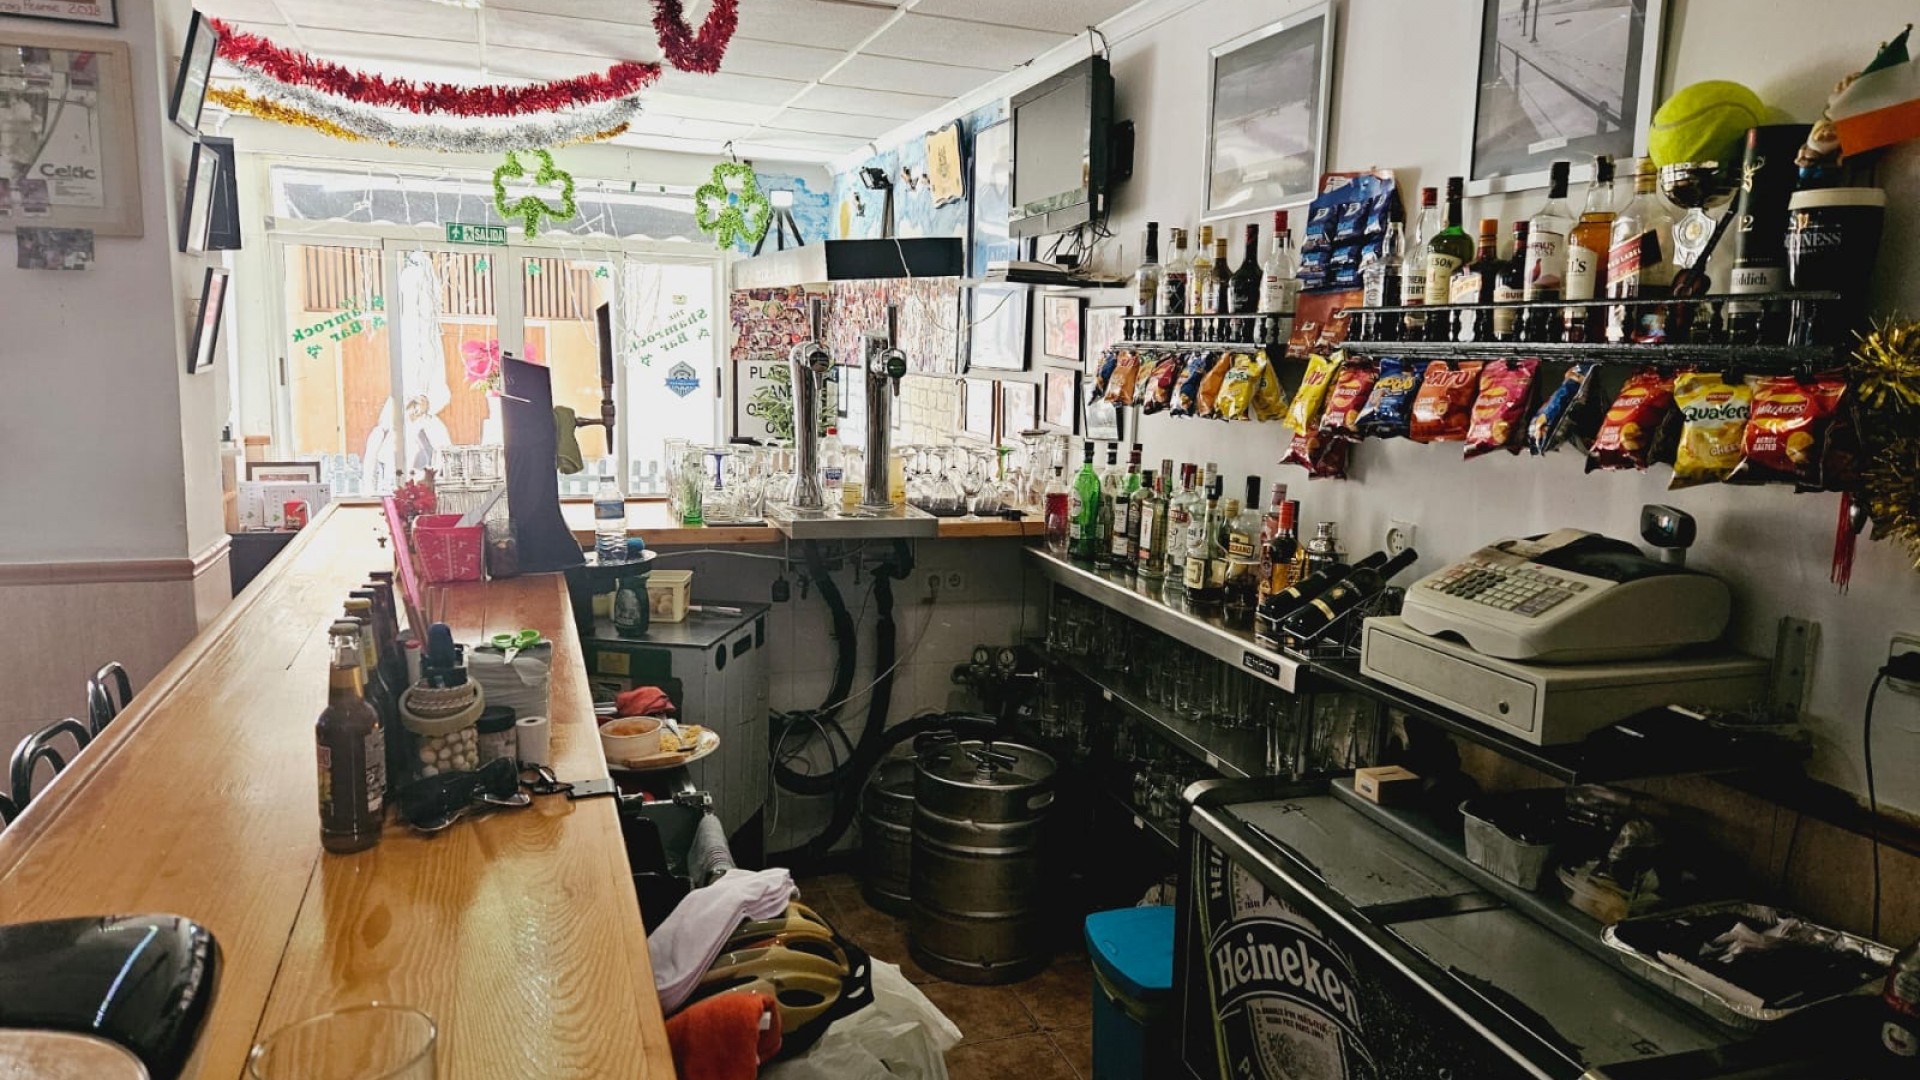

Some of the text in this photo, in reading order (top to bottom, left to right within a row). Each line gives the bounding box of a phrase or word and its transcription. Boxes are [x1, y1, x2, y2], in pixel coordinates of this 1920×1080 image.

[39, 163, 96, 180] Celtic
[473, 229, 505, 242] SALIDA
[1216, 932, 1363, 1033] Heineken
